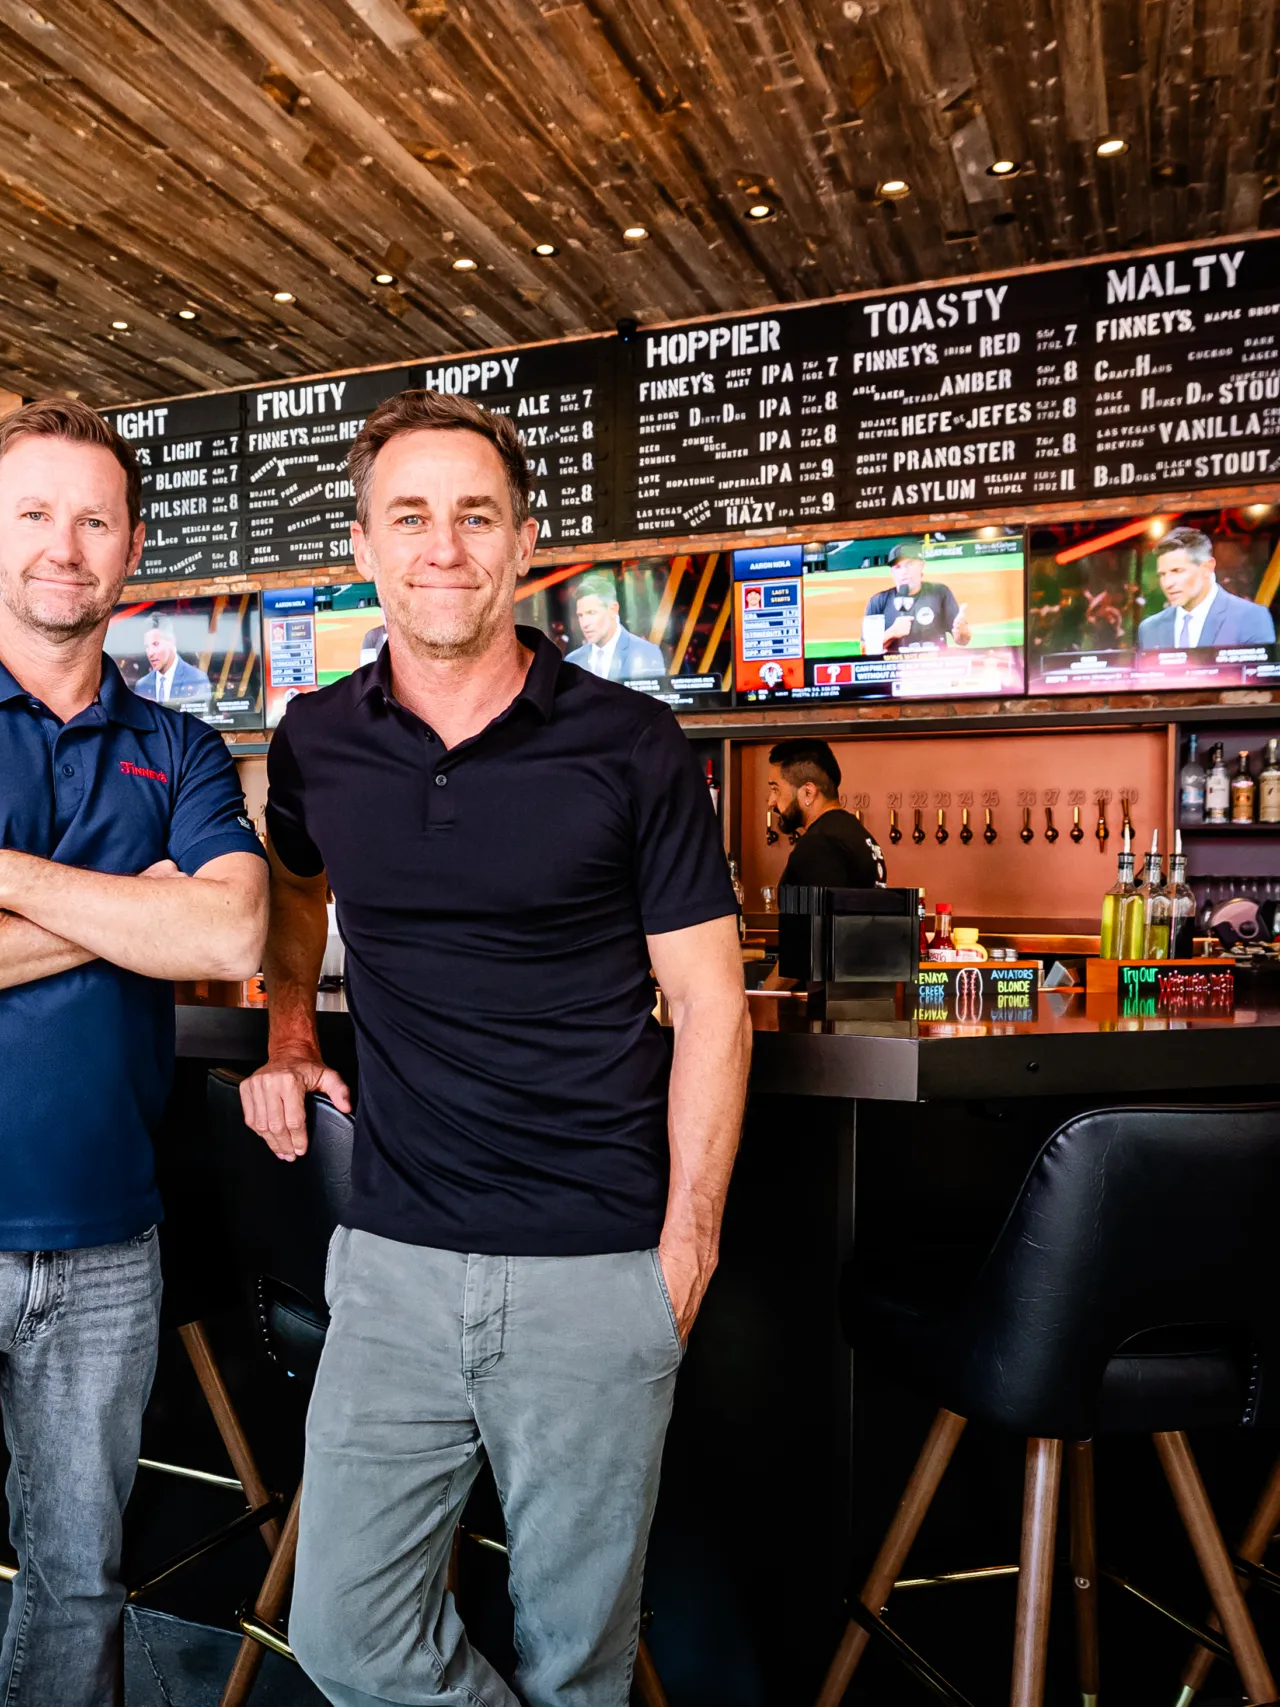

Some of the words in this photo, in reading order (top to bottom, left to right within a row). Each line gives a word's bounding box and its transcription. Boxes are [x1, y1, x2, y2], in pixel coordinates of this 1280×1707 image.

[1107, 250, 1246, 305] MALTY
[863, 285, 1008, 338] TOASTY
[647, 320, 780, 368] HOPPIER
[979, 331, 1020, 358] RED
[426, 357, 519, 395] HOPPY
[762, 362, 794, 385] IPA
[940, 368, 1012, 397] AMBER
[257, 381, 346, 422] FRUITY
[517, 395, 550, 417] ALE
[759, 396, 791, 419] IPA
[116, 408, 168, 439] IGHT
[901, 411, 952, 436] HEFE
[965, 402, 1032, 429] JEFES
[1062, 397, 1077, 418] 8
[1158, 412, 1261, 444] VANILLA
[163, 441, 202, 462] LIGHT
[759, 429, 791, 452] IPA
[893, 440, 1015, 472] PRANQSTER
[1195, 449, 1271, 478] STOUT
[156, 469, 207, 490] BLONDE
[760, 462, 792, 485] IPA
[856, 464, 887, 475] COAST
[856, 497, 887, 509] COAST
[891, 479, 976, 506] ASYLUM
[151, 497, 207, 519] PILSNER
[726, 501, 776, 526] HAZY
[778, 508, 794, 517] IPA
[120, 760, 168, 784] FINNEY'S
[854, 792, 869, 808] 20
[887, 792, 902, 808] 21
[911, 791, 928, 807] 22
[935, 791, 951, 807] 23
[958, 791, 974, 807] 24
[982, 790, 999, 807] 25
[1018, 789, 1036, 806] 26
[1044, 789, 1060, 806] 27
[1068, 789, 1086, 805] 28
[916, 972, 948, 984] ENAYA
[991, 970, 1033, 980] AVIATORS
[919, 985, 944, 996] CREEK
[998, 981, 1030, 993] BLONDE
